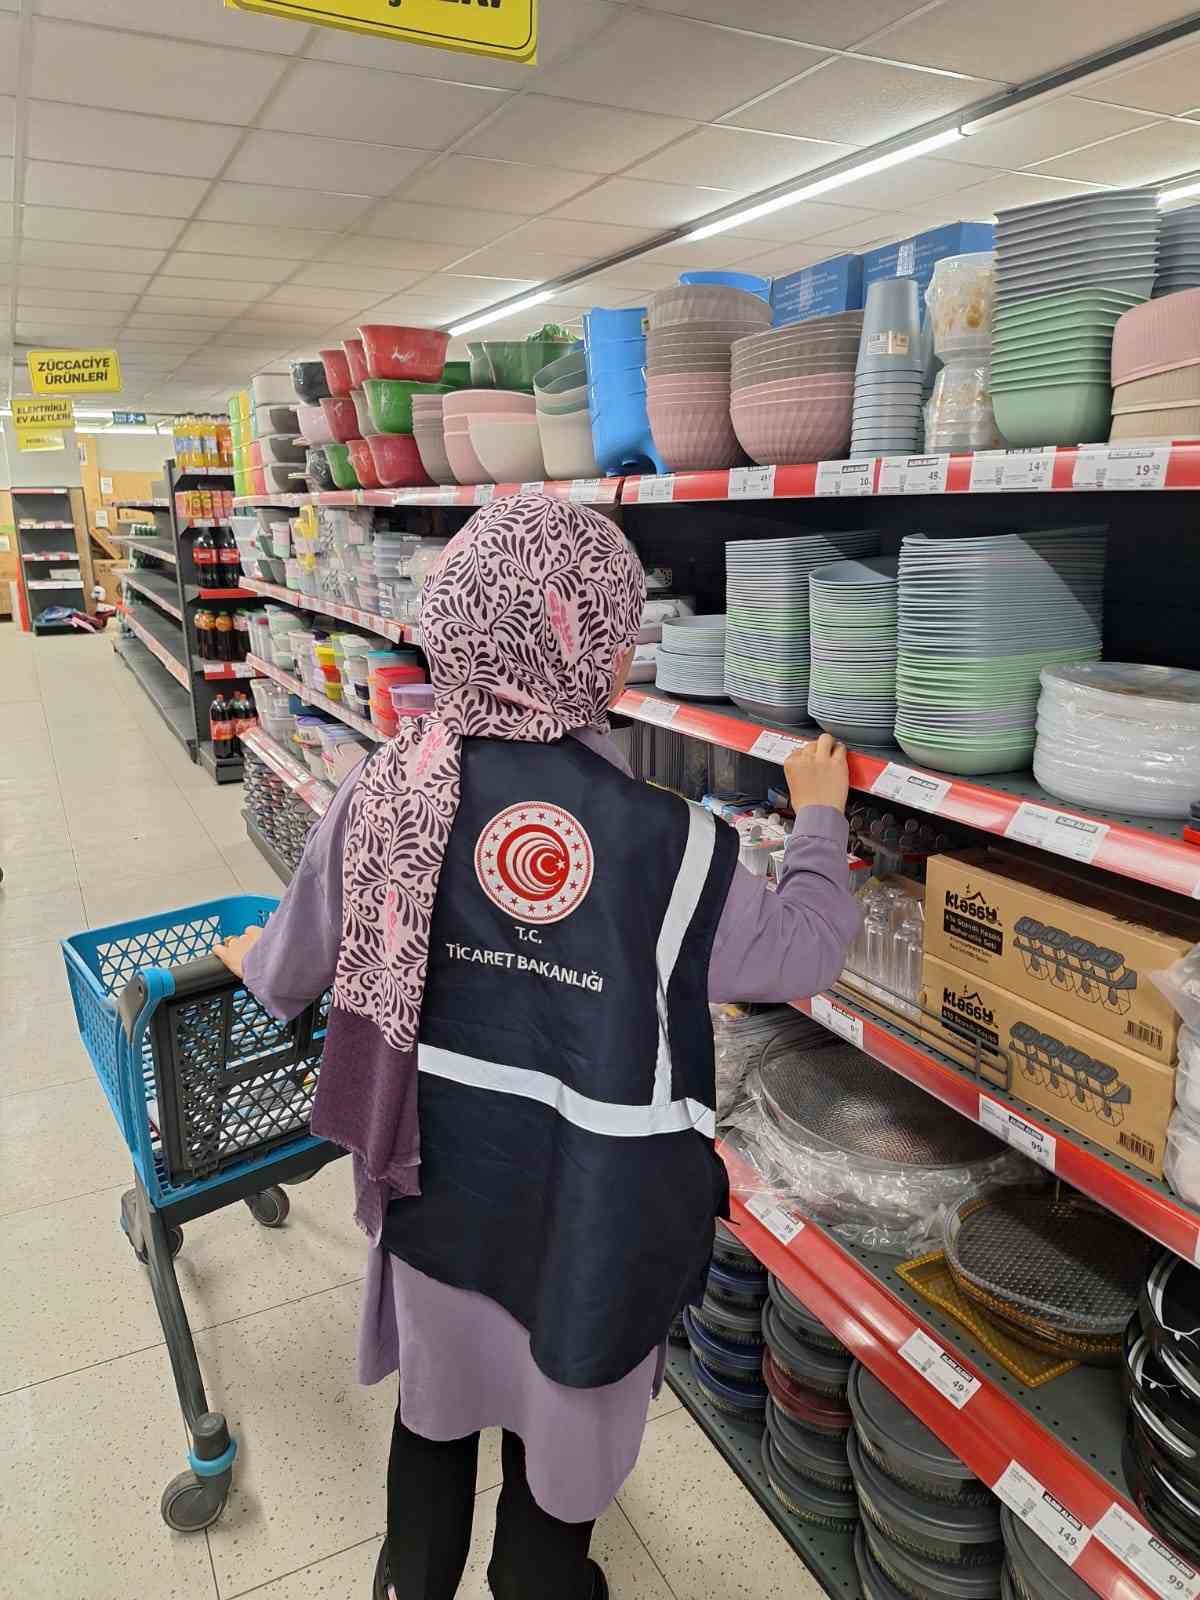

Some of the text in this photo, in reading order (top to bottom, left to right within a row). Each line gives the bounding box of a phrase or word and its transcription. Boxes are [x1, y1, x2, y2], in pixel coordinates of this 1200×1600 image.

[38, 356, 111, 372] ZÜCCACİYE
[45, 370, 108, 385] ÜRÜNLERİ
[16, 415, 28, 424] EV
[515, 926, 542, 944] T.C.
[446, 943, 603, 993] TİCARET BAKANLIĞI
[1058, 1526, 1077, 1546] 149
[1167, 1575, 1184, 1590] 99
